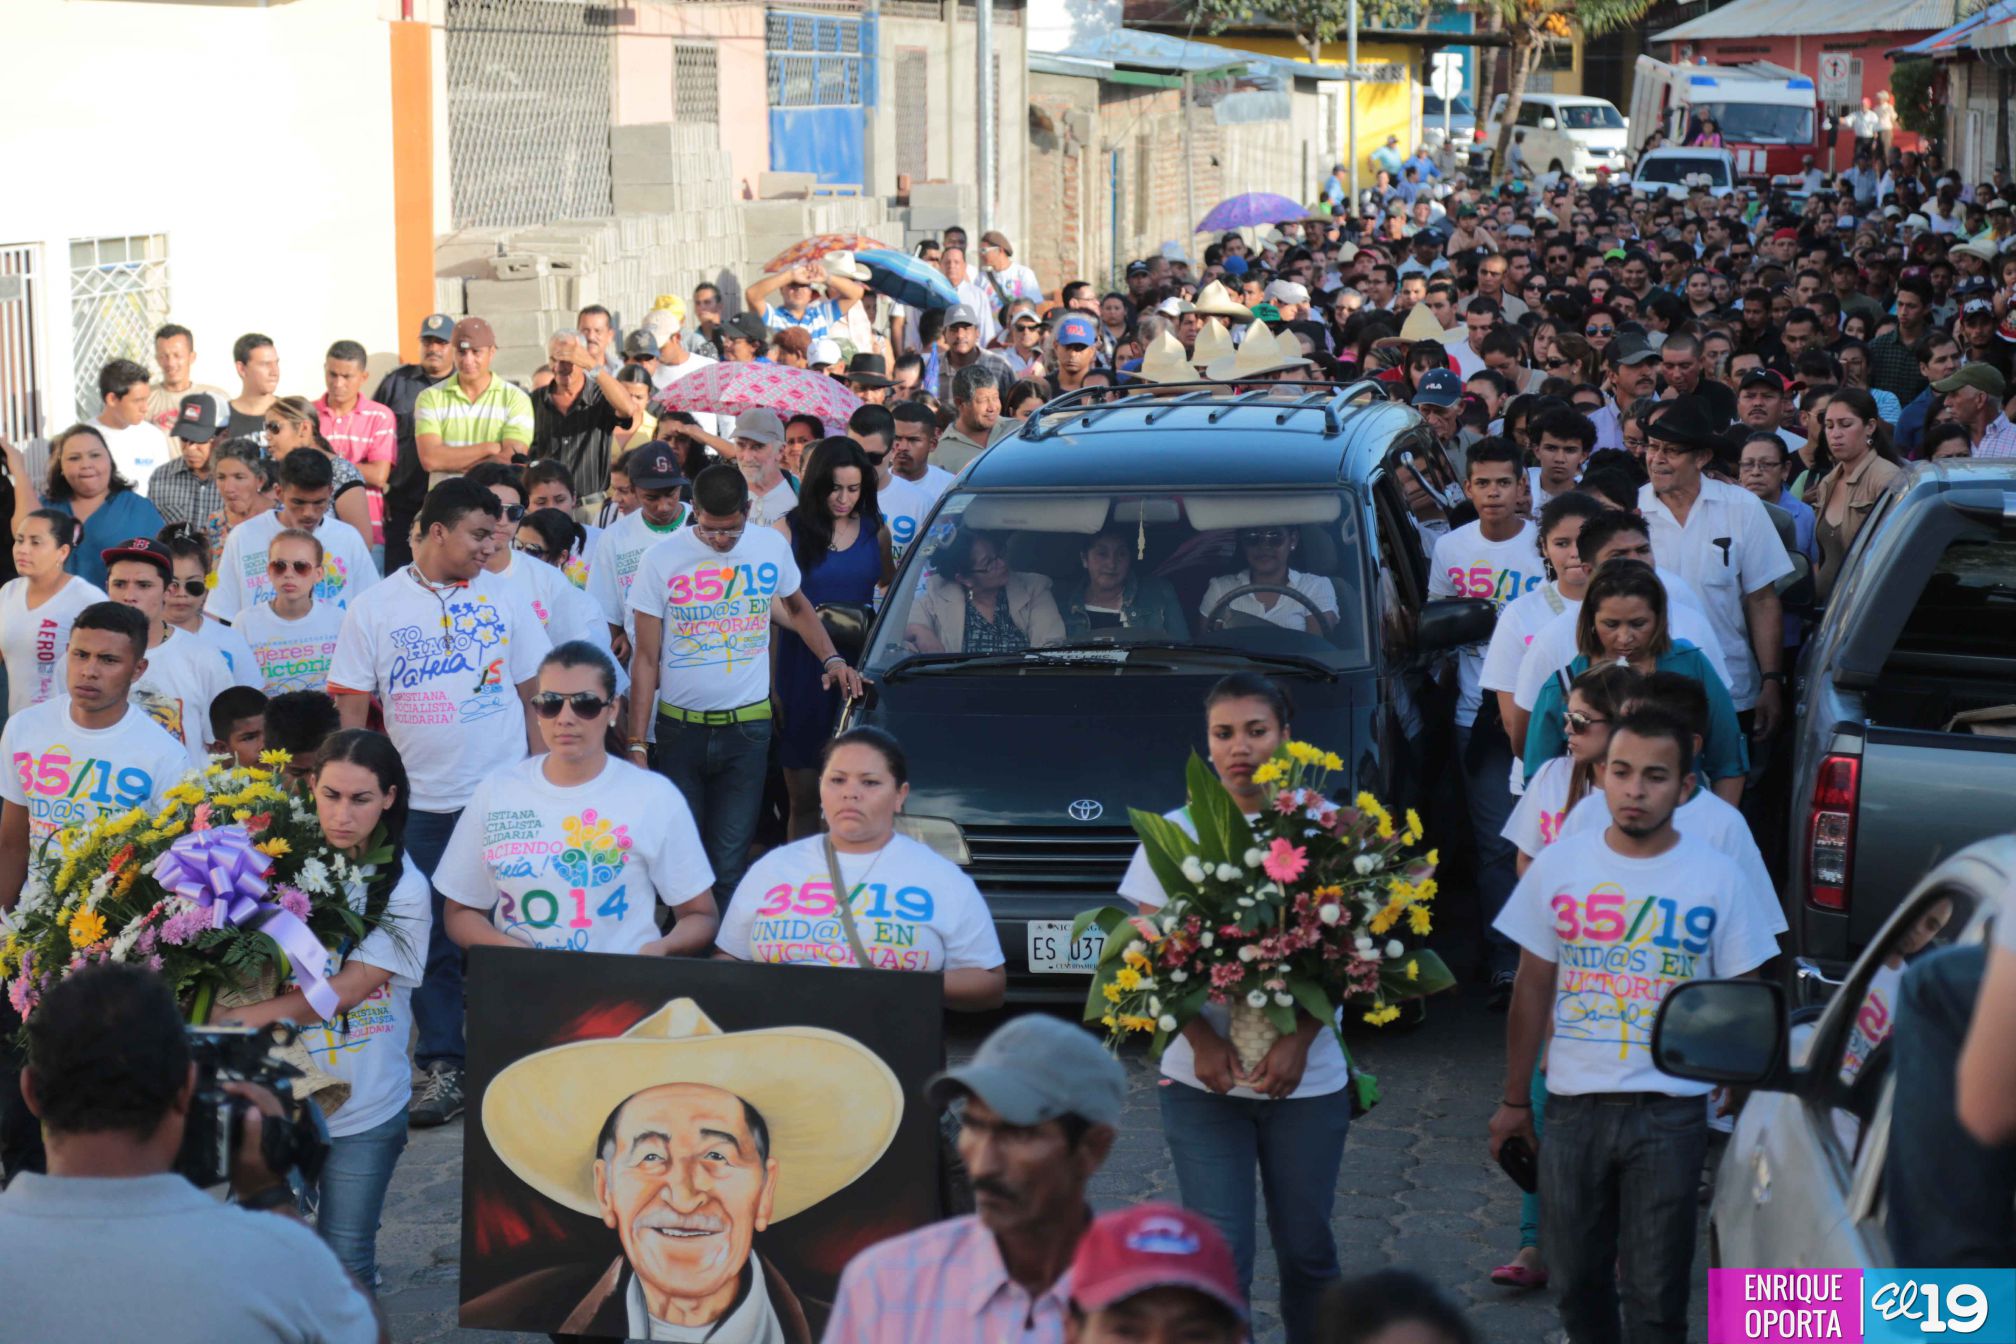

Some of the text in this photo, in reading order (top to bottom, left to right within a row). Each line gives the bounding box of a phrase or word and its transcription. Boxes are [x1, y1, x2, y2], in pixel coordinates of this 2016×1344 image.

[668, 562, 779, 605] 35/19
[37, 618, 59, 661] AERO
[391, 625, 422, 648] YO
[13, 751, 154, 806] 35/19
[499, 884, 629, 929] 2014
[757, 882, 935, 923] 35/19
[1551, 893, 1718, 954] 35/19
[752, 920, 915, 946] UNID@ EN
[1033, 937, 1105, 960] ES 037
[1560, 944, 1697, 977] NID@S EN
